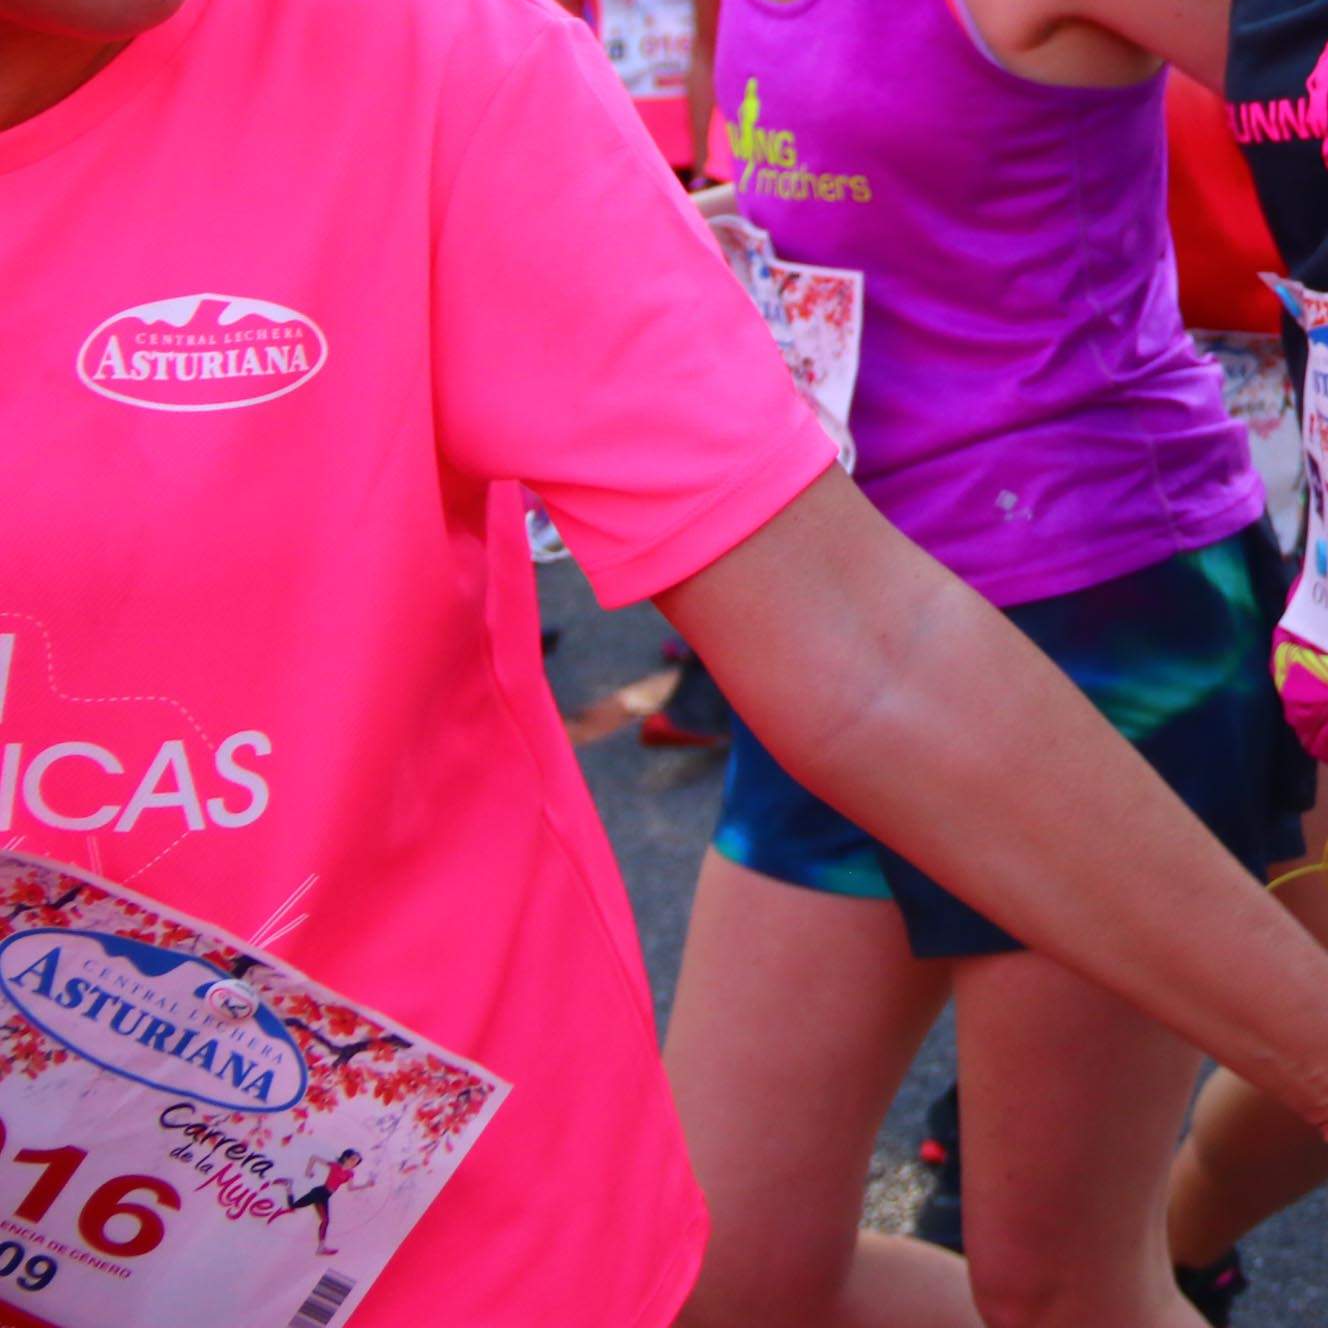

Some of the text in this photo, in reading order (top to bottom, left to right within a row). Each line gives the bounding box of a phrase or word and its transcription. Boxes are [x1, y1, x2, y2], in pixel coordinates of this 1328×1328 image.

[756, 163, 873, 203] mothers
[93, 334, 310, 381] ASTURIANA
[135, 327, 304, 346] CENTRAL LECHERA
[8, 946, 275, 1102] ASTURIANA
[84, 959, 285, 1065] CENTRAL LECHERA
[159, 1102, 275, 1179] Carrera
[0, 1118, 182, 1258] 16
[169, 1140, 296, 1225] de la Mujer
[47, 1240, 68, 1254] DE
